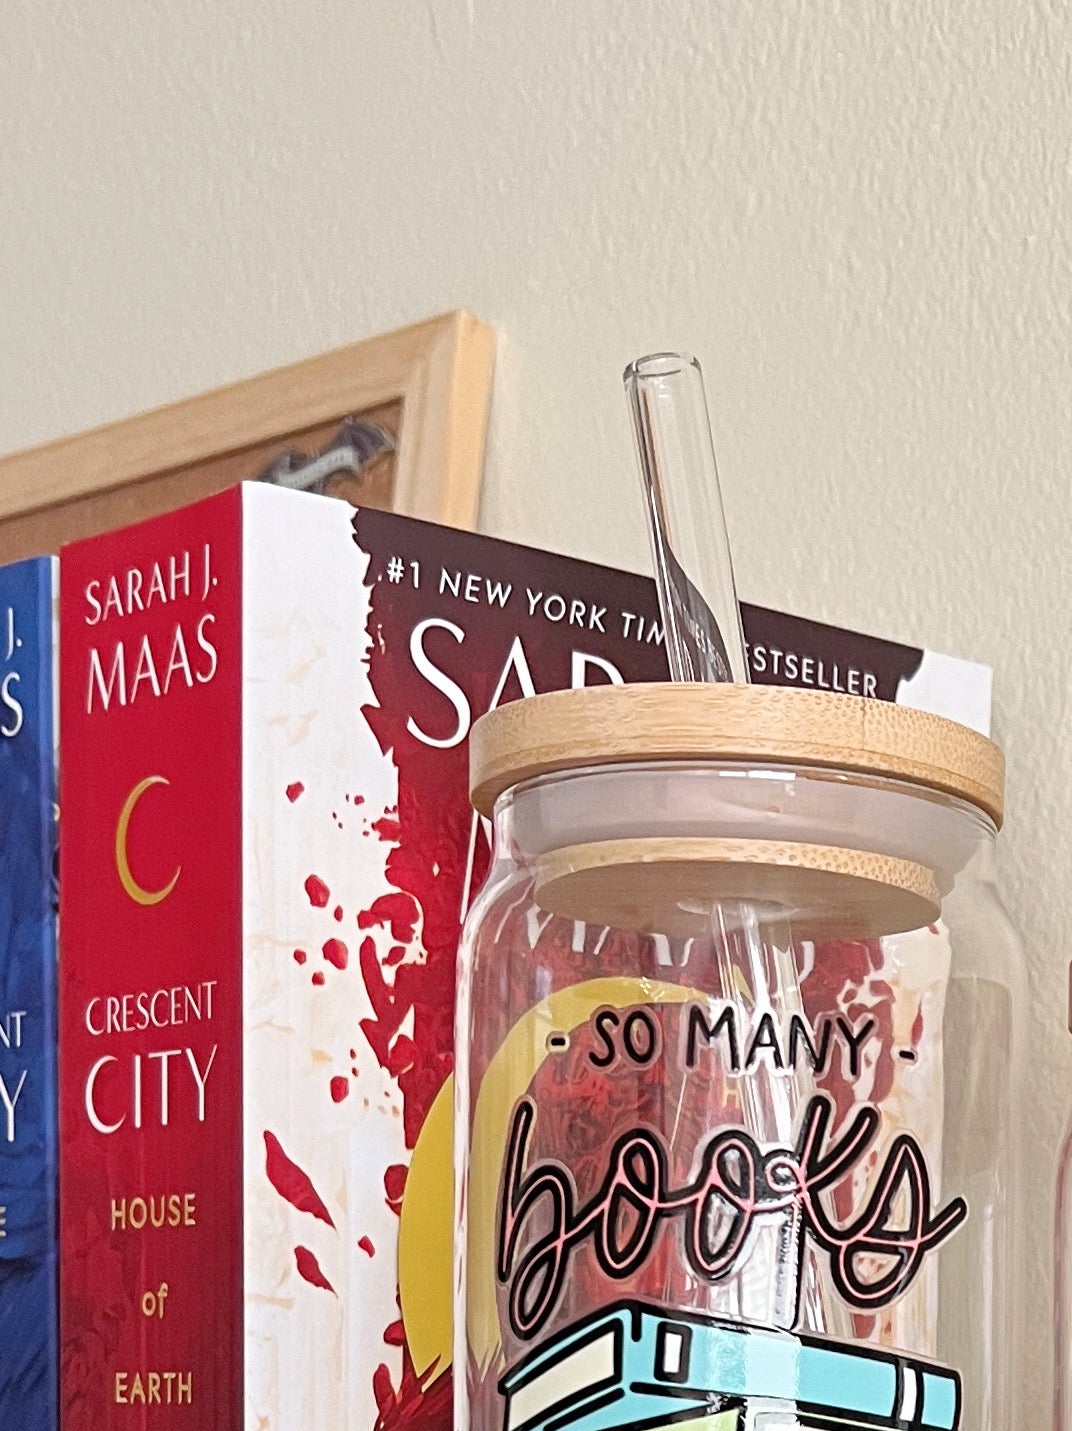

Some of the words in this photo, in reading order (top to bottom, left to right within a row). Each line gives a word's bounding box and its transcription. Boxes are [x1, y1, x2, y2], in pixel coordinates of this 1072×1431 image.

[86, 549, 190, 625] SARAH
[201, 544, 218, 601] J.
[5, 607, 22, 661] J.
[386, 556, 420, 589] #1
[439, 566, 512, 608] NEW
[526, 588, 607, 633] YORK
[744, 644, 877, 698] STSELLER
[86, 614, 218, 714] MAAS
[86, 981, 217, 1036] CRESCENT
[589, 1010, 655, 1068] SO
[686, 1005, 874, 1076] MANY
[86, 1044, 218, 1134] CITY
[111, 1193, 196, 1230] HOUSE
[500, 1095, 967, 1341] books
[142, 1283, 168, 1317] of
[115, 1372, 193, 1405] EARTH
